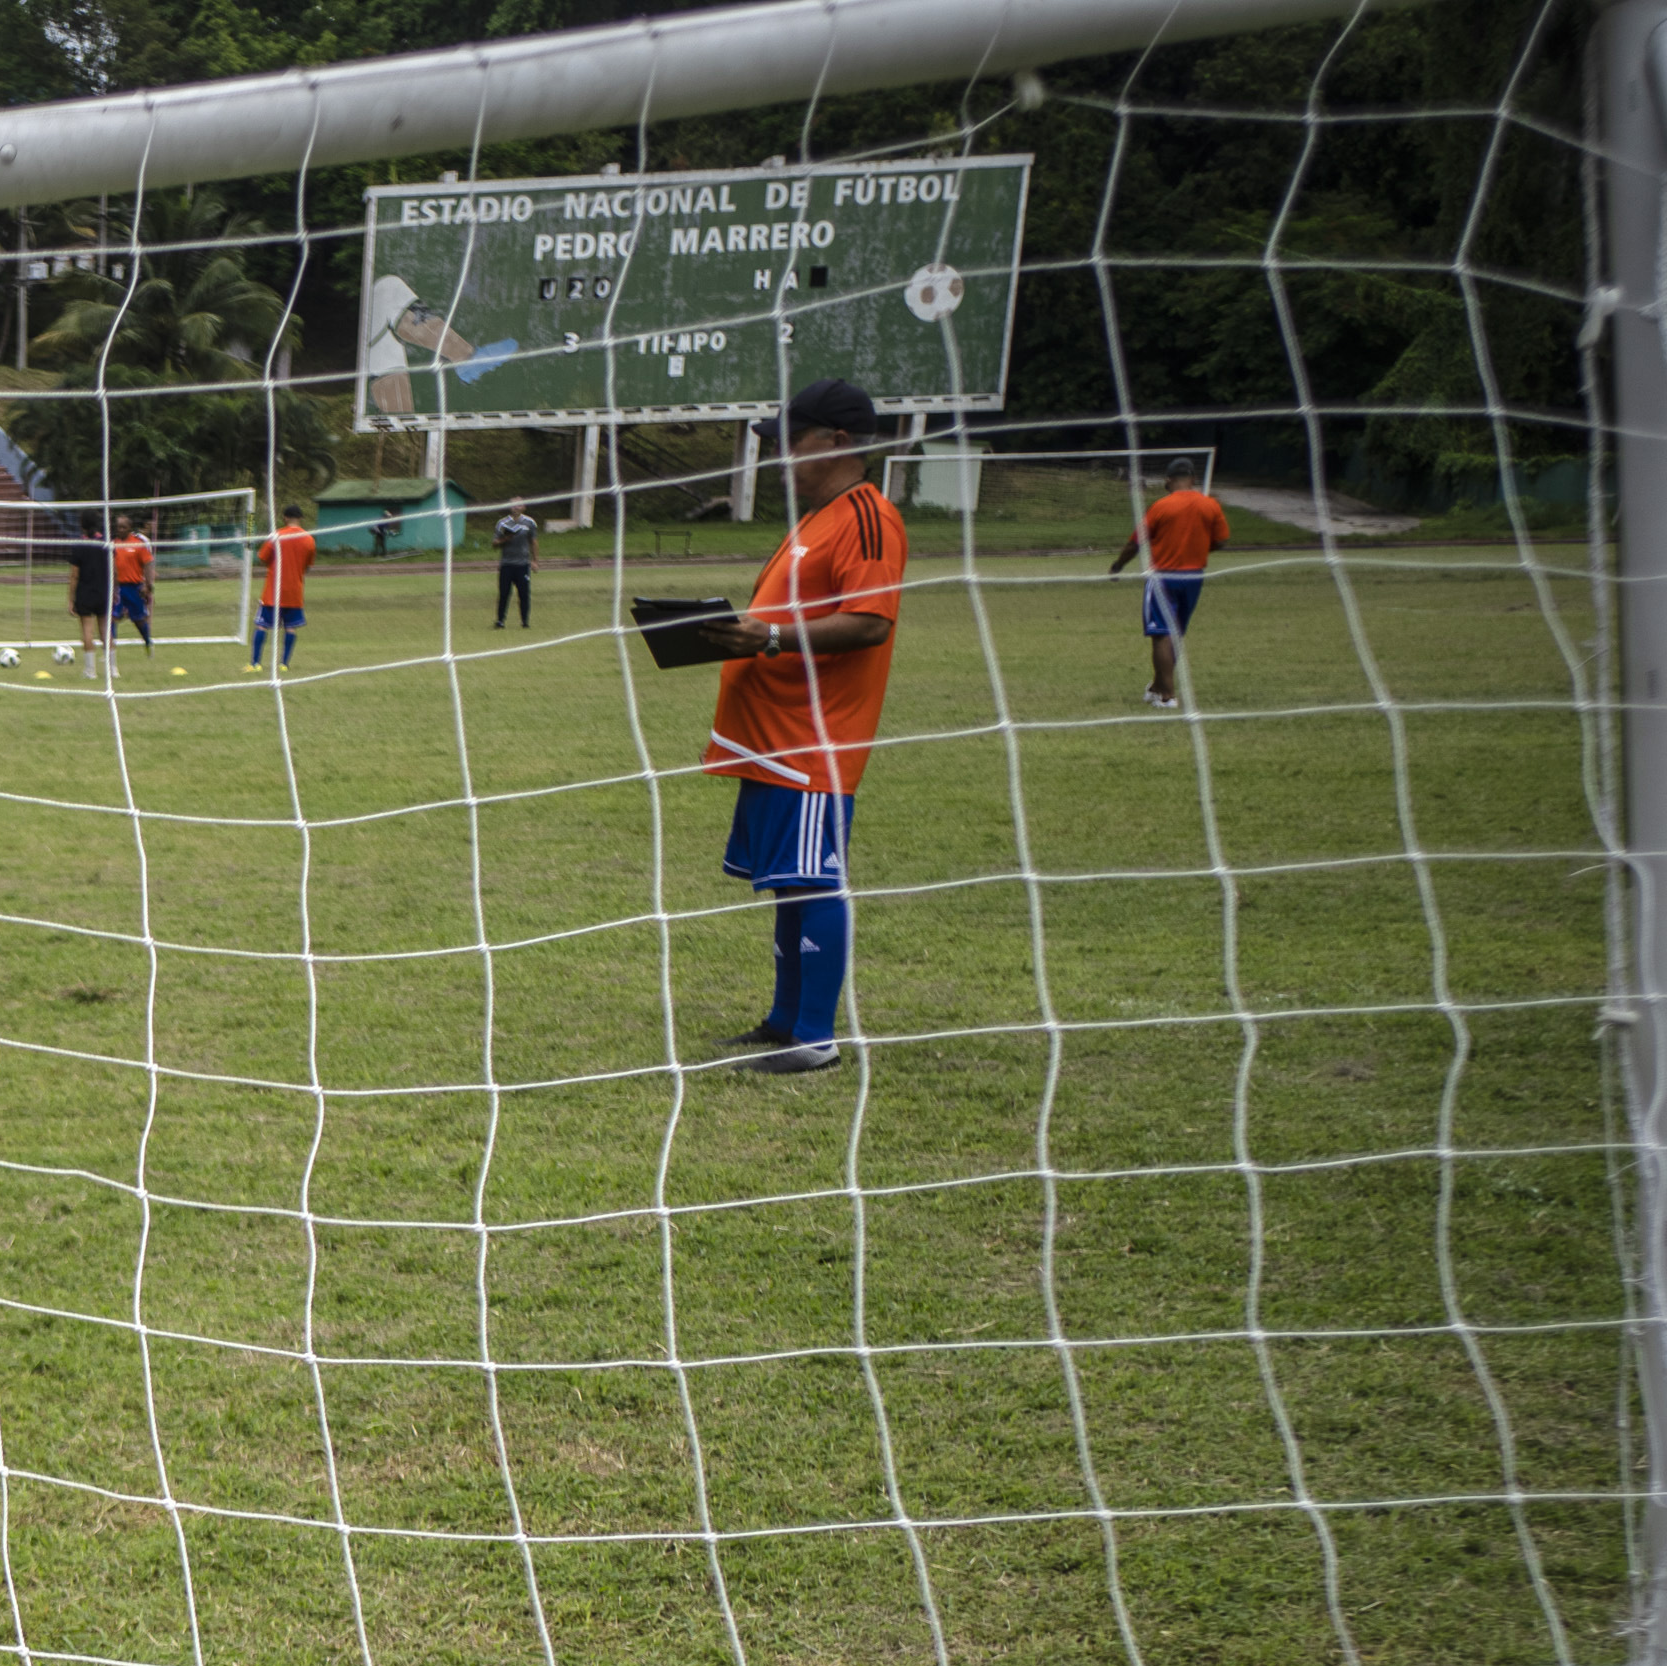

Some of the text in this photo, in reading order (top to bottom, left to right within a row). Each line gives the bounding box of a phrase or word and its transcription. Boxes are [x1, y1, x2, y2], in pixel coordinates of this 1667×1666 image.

[401, 171, 959, 227] ESTADIO NACIONAL DE FÚTBOL
[533, 220, 836, 261] PEDRO MARRERO
[563, 331, 581, 354] 3
[778, 322, 795, 345] 2
